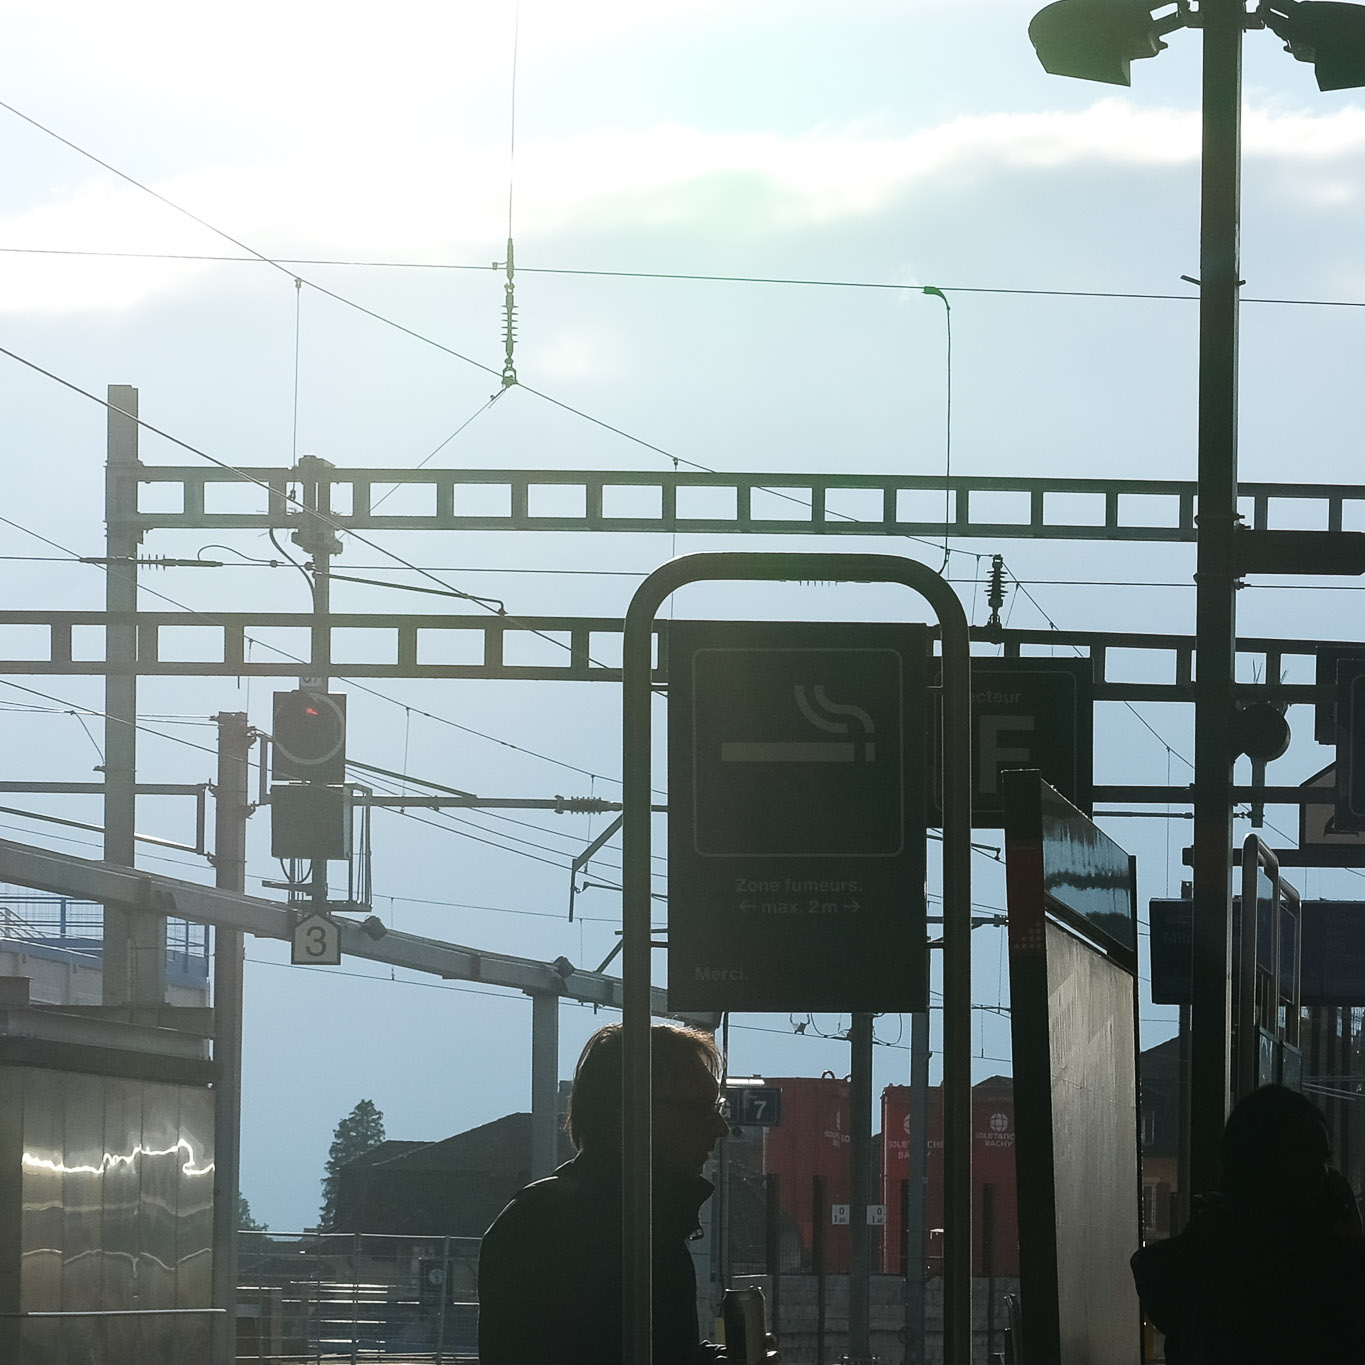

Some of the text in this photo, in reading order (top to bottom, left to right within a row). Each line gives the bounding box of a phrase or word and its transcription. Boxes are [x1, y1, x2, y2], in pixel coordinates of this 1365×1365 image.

[971, 690, 1023, 704] cteur
[978, 715, 1035, 794] F
[735, 877, 864, 893] Zone fumeurs.
[761, 901, 803, 914] max.
[304, 926, 328, 956] 3
[695, 964, 751, 983] Merci.
[753, 1100, 767, 1120] 7
